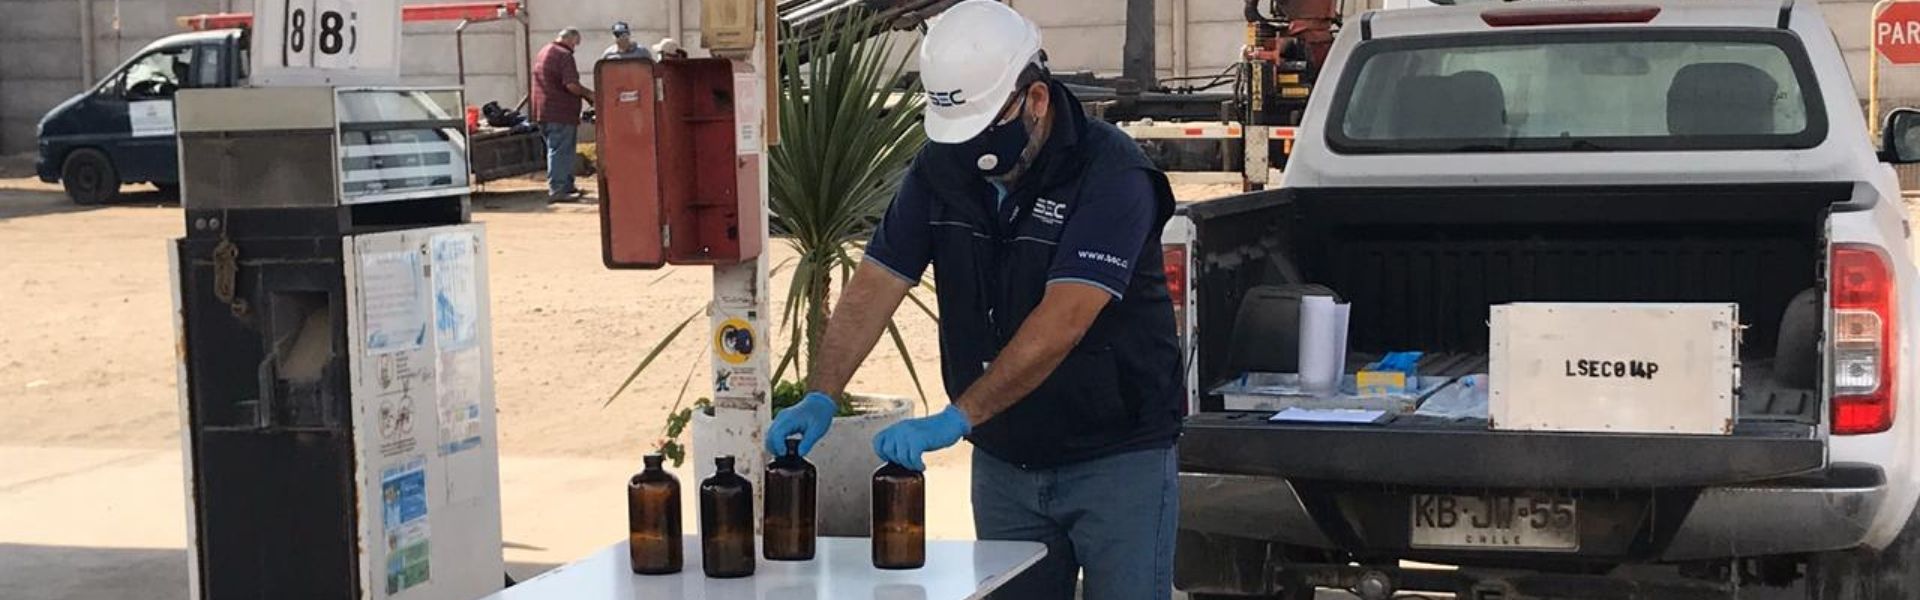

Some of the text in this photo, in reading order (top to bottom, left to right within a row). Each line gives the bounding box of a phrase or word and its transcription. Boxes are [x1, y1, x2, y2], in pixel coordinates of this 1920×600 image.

[1877, 21, 1920, 46] PAR
[928, 89, 967, 107] SEC
[1033, 197, 1067, 220] SEC
[1078, 250, 1129, 269] www.sec.c
[1464, 534, 1522, 546] CHILE
